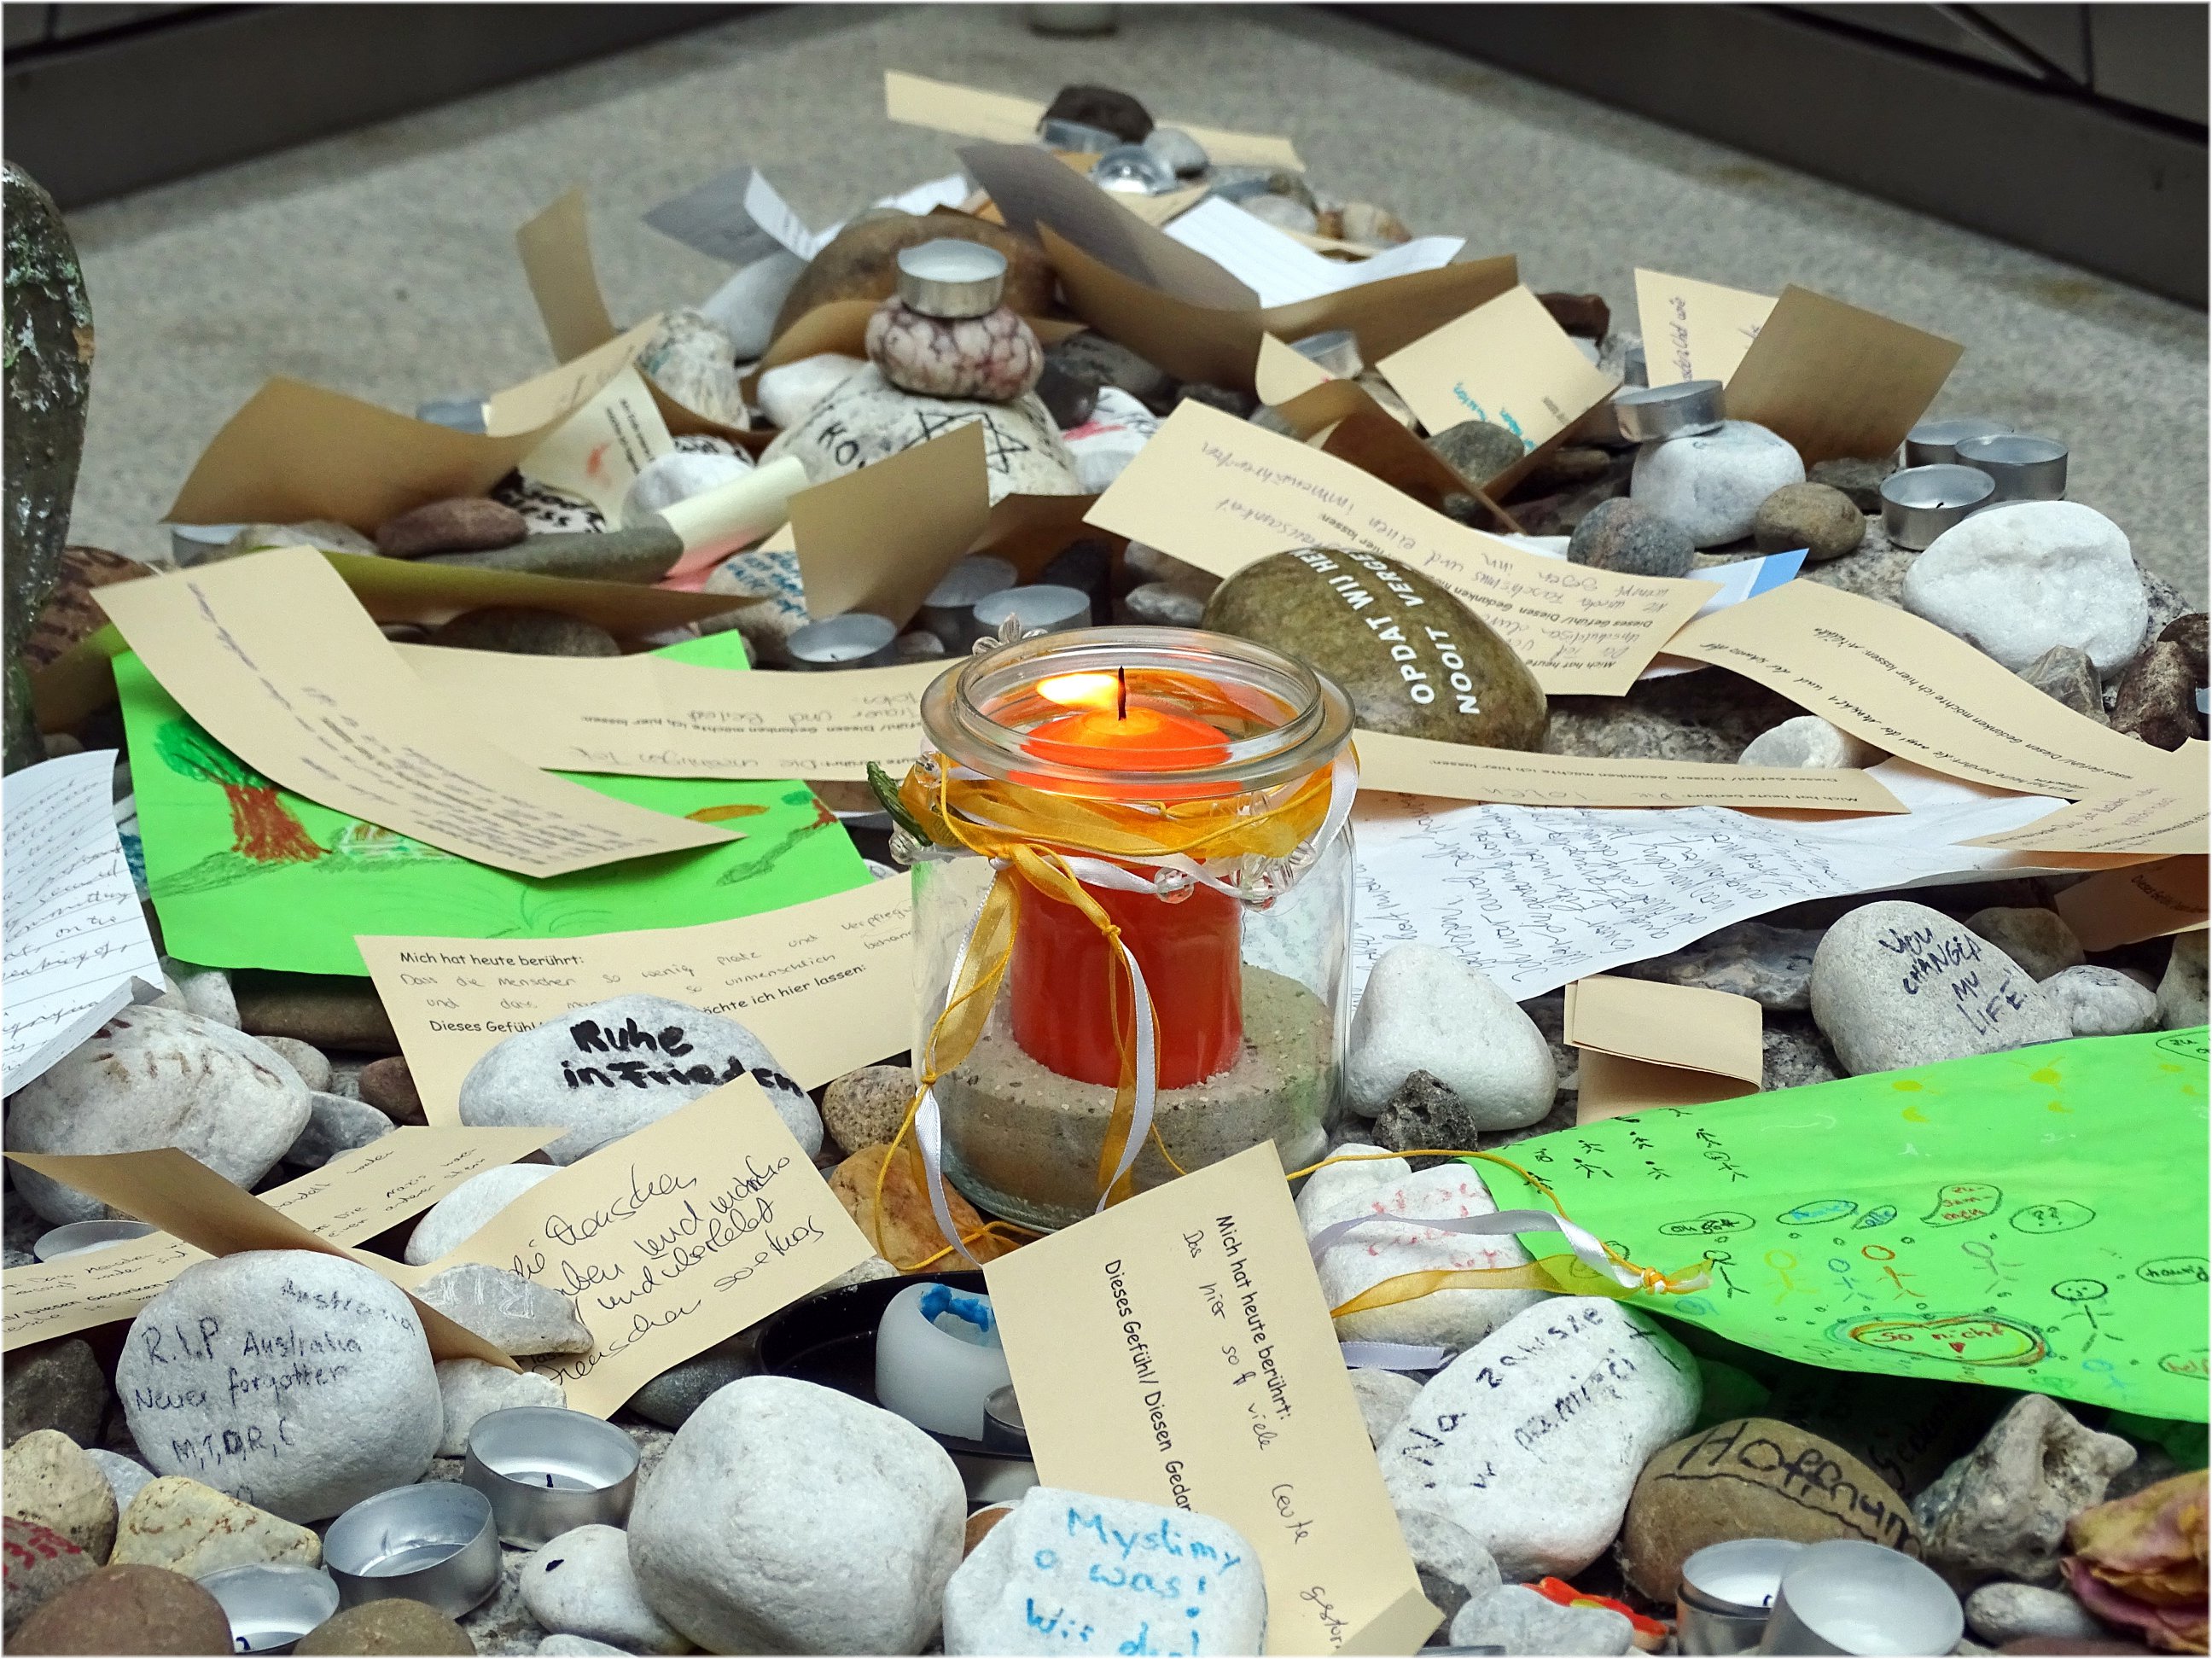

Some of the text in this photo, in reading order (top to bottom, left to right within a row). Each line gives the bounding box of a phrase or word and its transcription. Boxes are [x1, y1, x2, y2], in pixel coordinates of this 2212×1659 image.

[1328, 574, 1375, 610] WIJ
[1347, 550, 1425, 608] VERGE
[1454, 585, 1513, 613] Gedanken
[1520, 607, 1560, 621] Diesen
[1365, 614, 1435, 705] OPDAT
[1426, 624, 1481, 715] NOOIT
[1525, 659, 1616, 669] Mich hat heute
[1862, 649, 1898, 672] lassen:
[1895, 671, 1919, 687] hier
[1918, 684, 1936, 696] ich
[1935, 694, 1974, 719] möchte
[1972, 717, 2023, 744] Gedanken
[1483, 764, 1512, 772] hier
[2025, 743, 2062, 760] Diesen
[1541, 768, 1595, 777] möchte
[400, 952, 584, 967] Mich hat heute berührt:
[641, 963, 696, 980] wenig
[788, 934, 820, 949] und
[429, 963, 868, 1033] Dieses Gefühl öchte ich hier lassen:
[569, 1017, 694, 1057] Ruhe
[1215, 1214, 1240, 1259] Mich
[85, 1281, 164, 1302] Gedanken
[1230, 1258, 1253, 1293] hat
[1241, 1292, 1266, 1345] heute
[1103, 1258, 1133, 1319] Dieses
[1123, 1318, 1160, 1386] Gefühl/
[1144, 1390, 1173, 1453] Diesen
[1198, 1282, 1227, 1322] hier
[1221, 1344, 1241, 1366] so
[1248, 1400, 1272, 1452] viele
[227, 1362, 350, 1408] forgotten
[1256, 1343, 1294, 1422] berührt:
